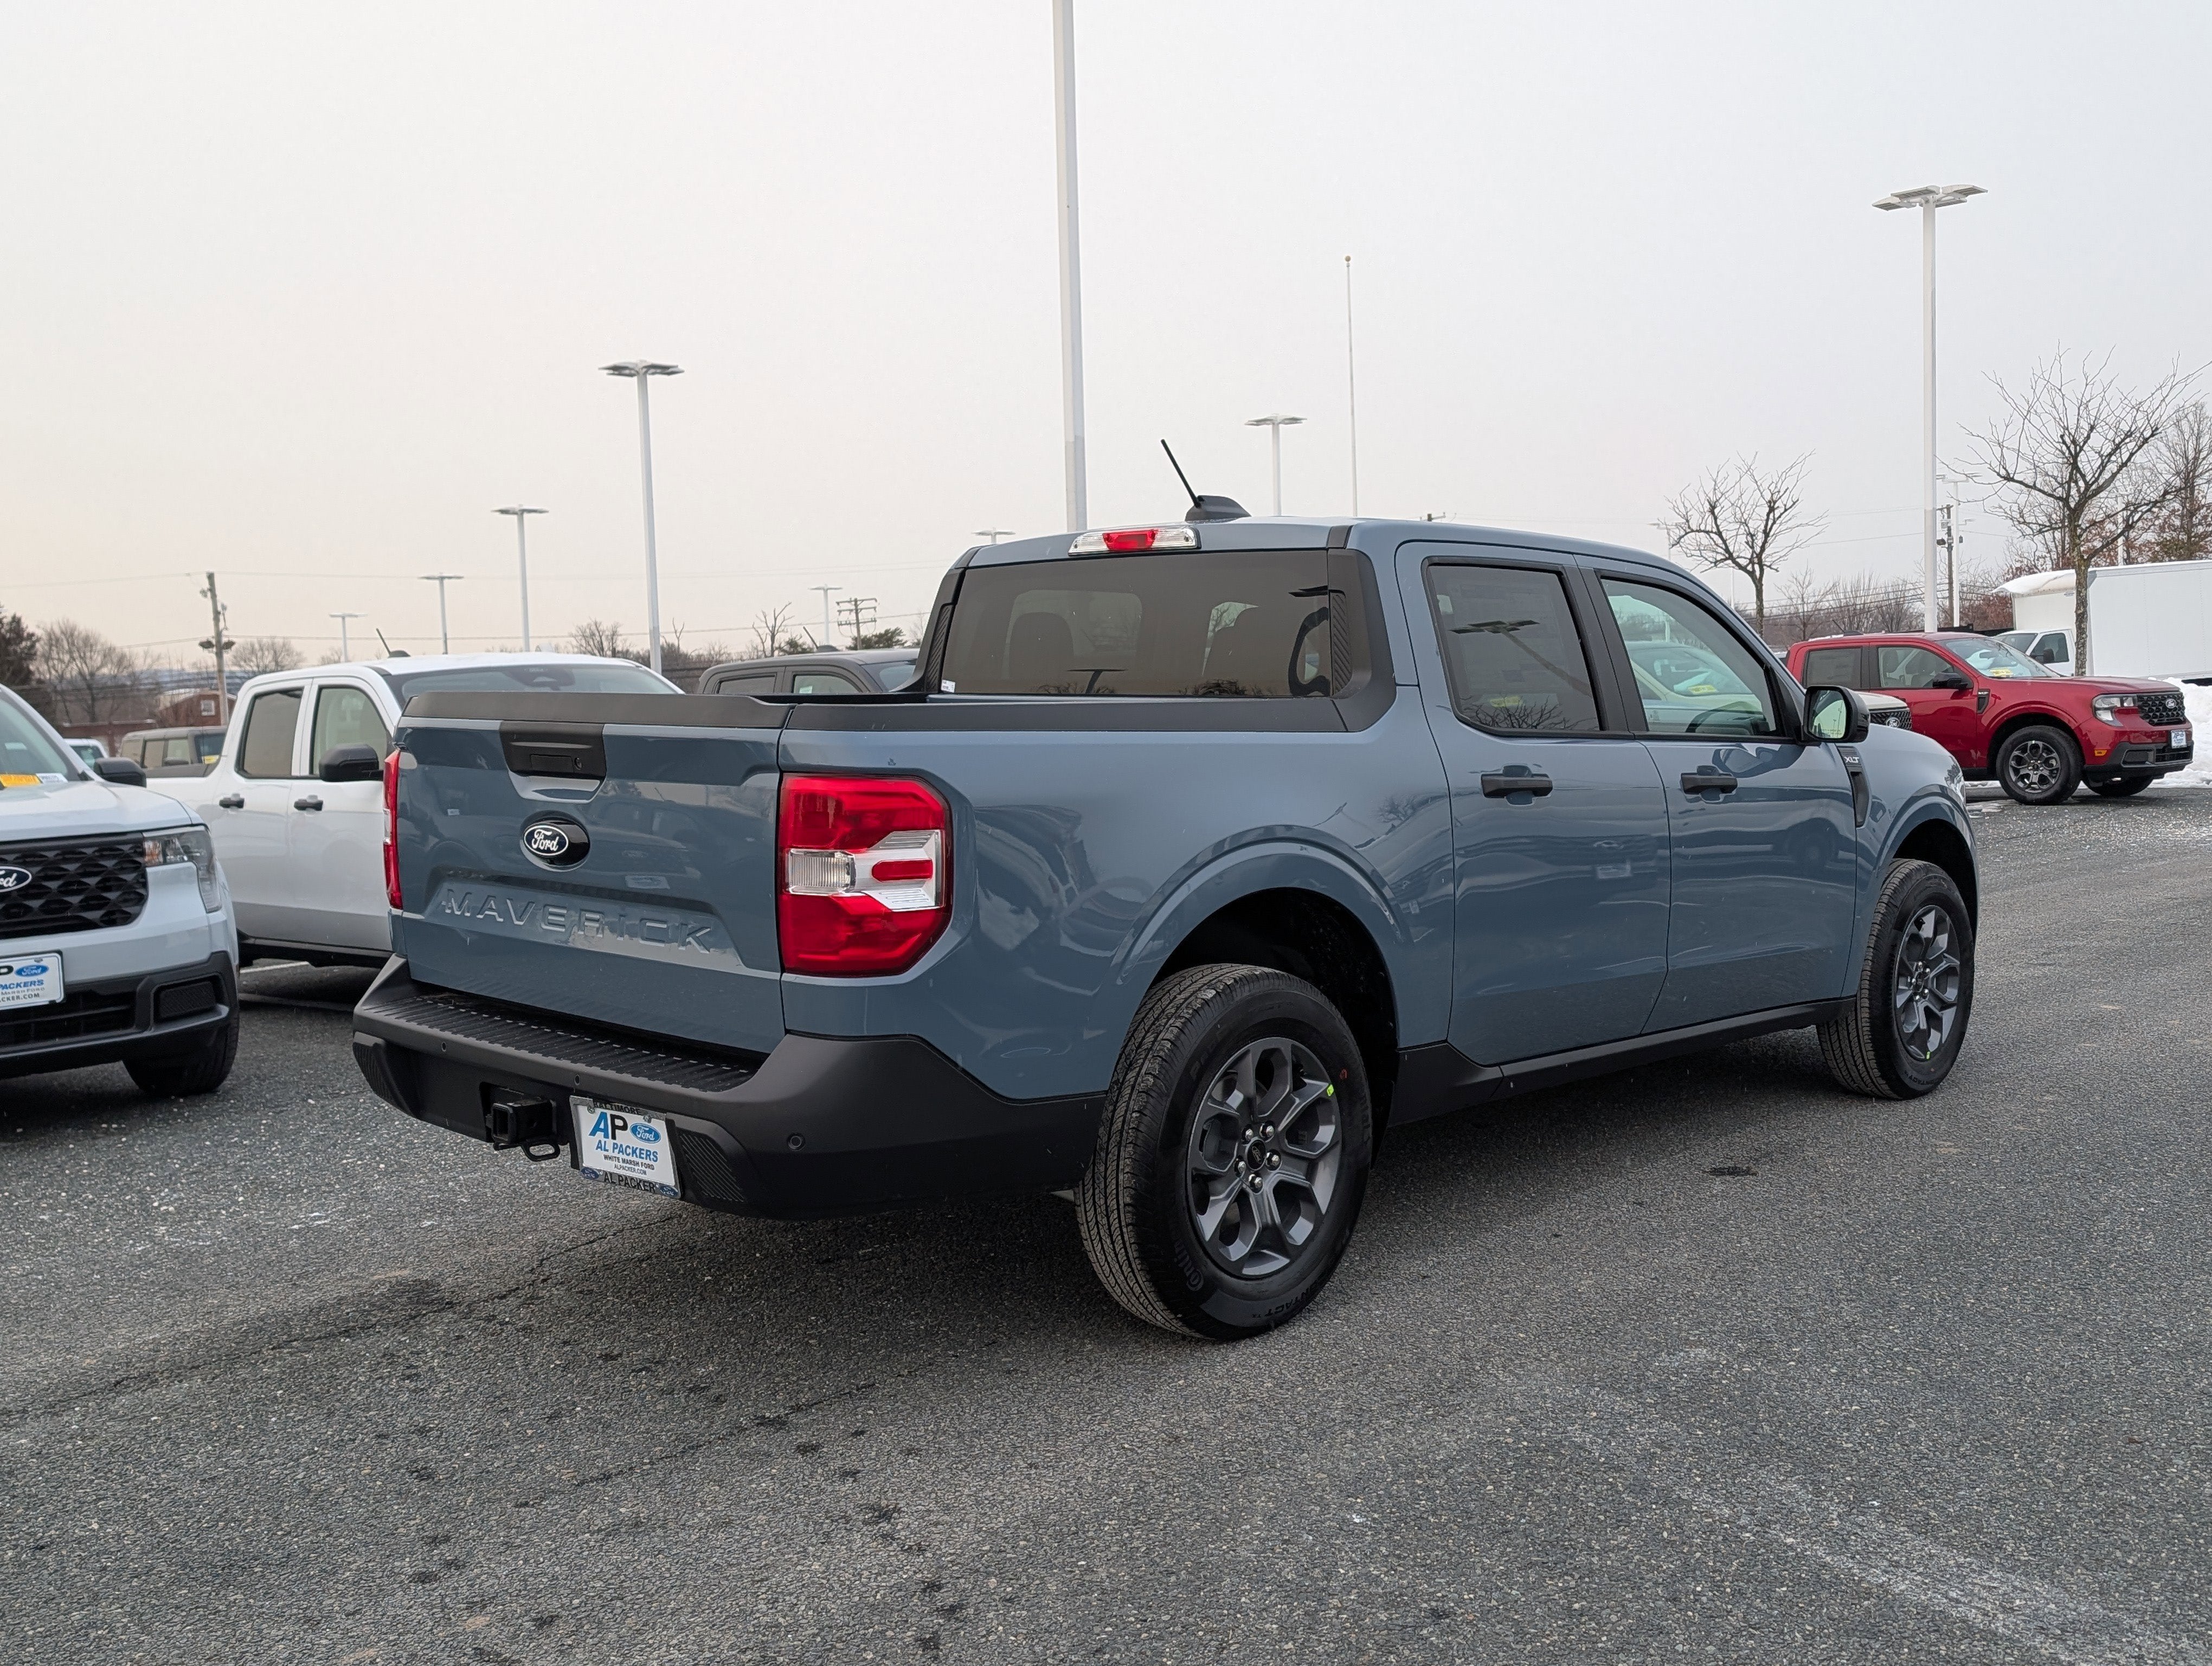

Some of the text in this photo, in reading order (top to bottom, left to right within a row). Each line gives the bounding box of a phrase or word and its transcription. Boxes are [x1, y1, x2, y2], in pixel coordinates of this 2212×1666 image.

[531, 829, 560, 851] Ford
[443, 888, 711, 953] MAVERICK
[0, 993, 40, 1002] CKER.COM
[594, 1101, 642, 1115] BALTIMORE
[589, 1111, 628, 1140] AP
[596, 1139, 658, 1163] AL PACKERS
[603, 1154, 655, 1170] WHITE MARSH FORD
[614, 1164, 647, 1175] ALPACKER.COM
[604, 1171, 655, 1193] AL PACKER
